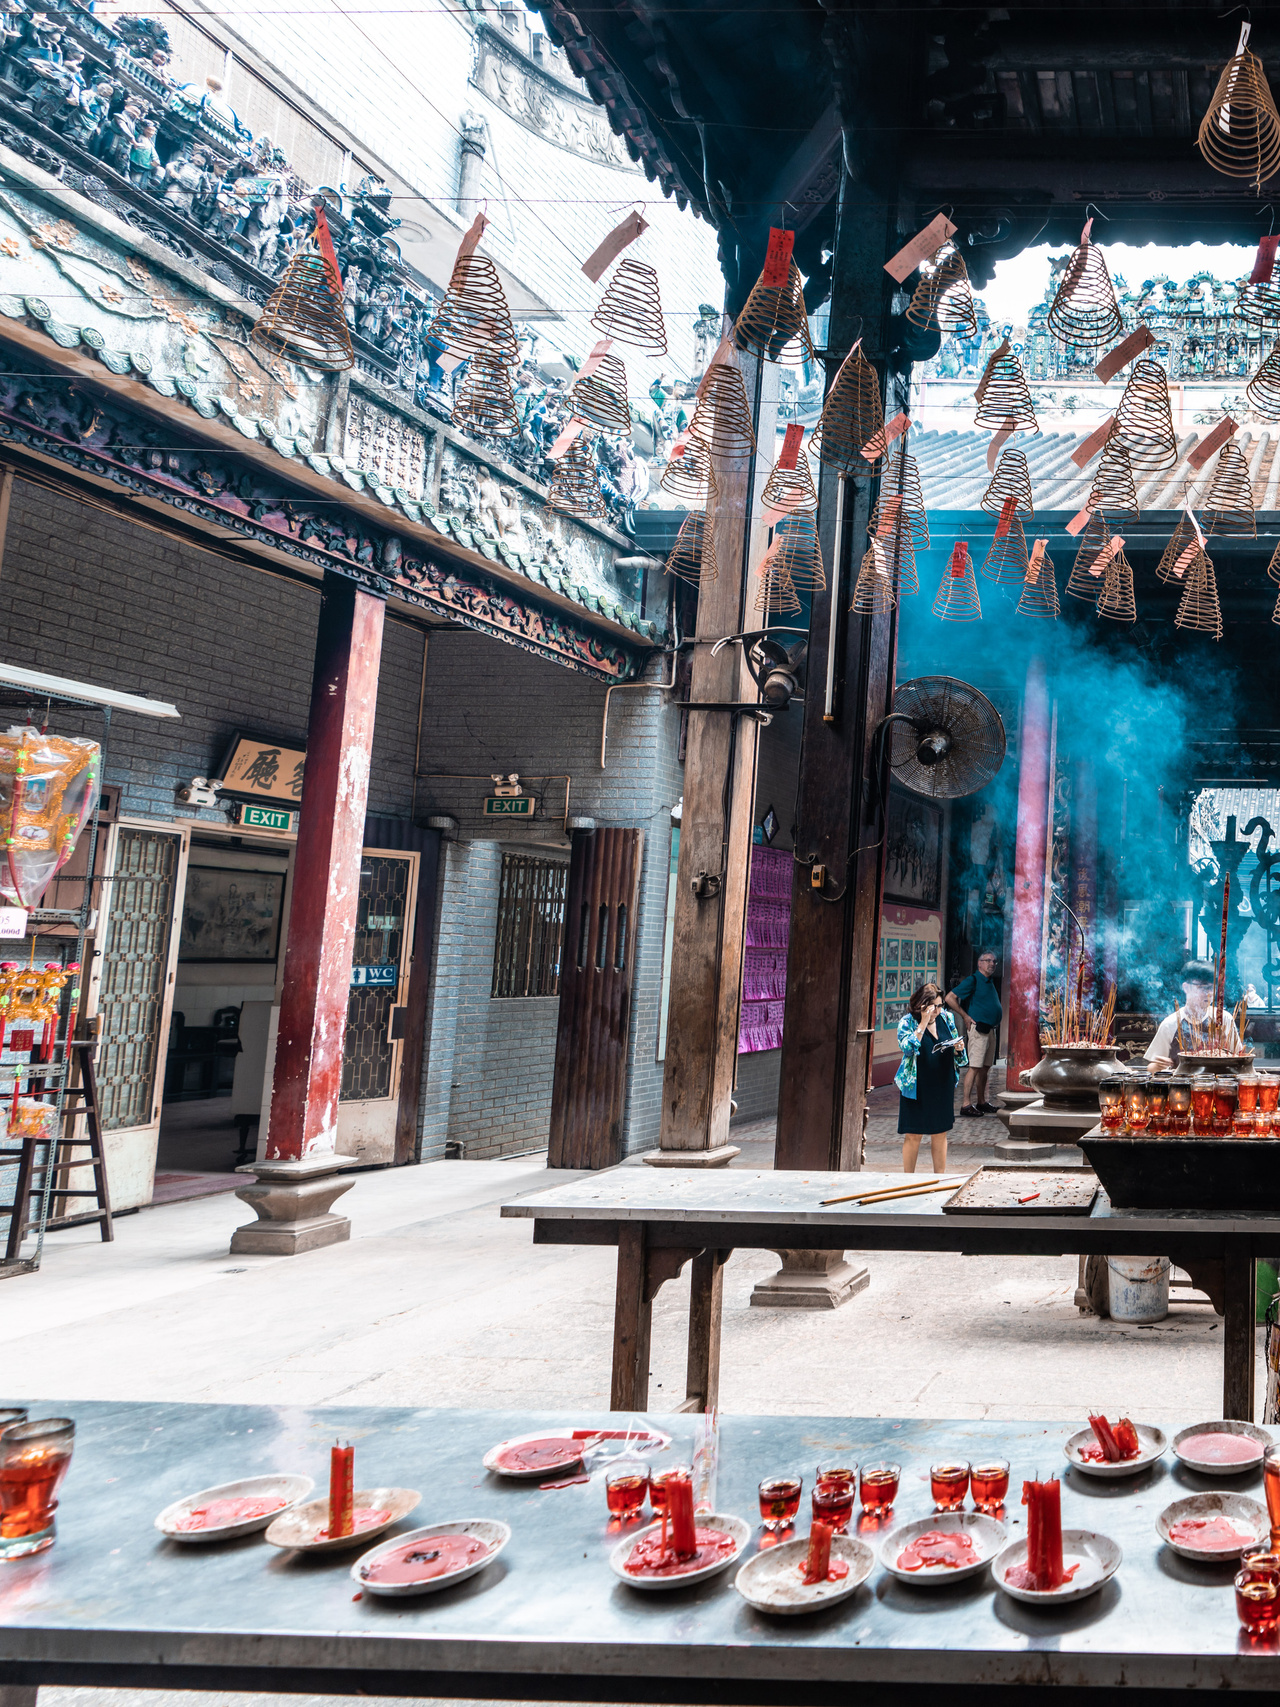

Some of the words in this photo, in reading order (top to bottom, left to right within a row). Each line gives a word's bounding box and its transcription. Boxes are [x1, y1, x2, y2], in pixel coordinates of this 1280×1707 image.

[492, 801, 525, 812] EXIT
[249, 809, 285, 827] EXIT
[369, 968, 393, 978] WC
